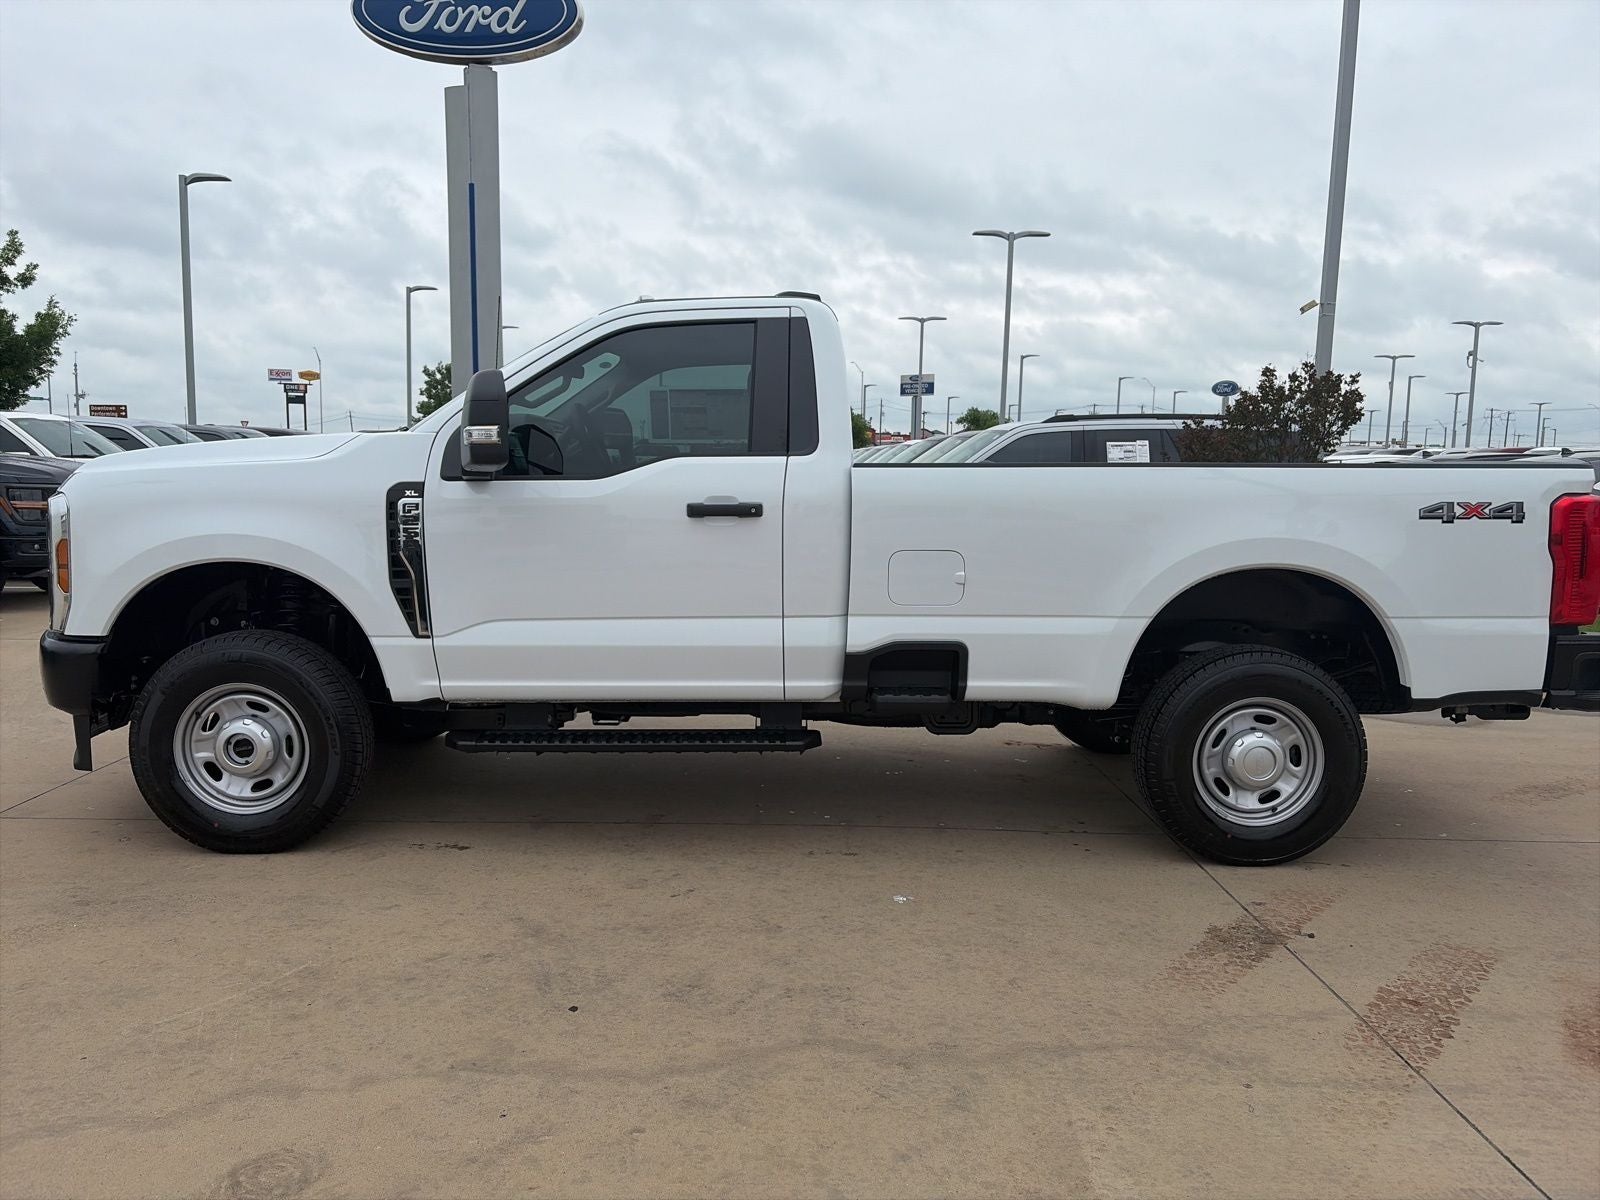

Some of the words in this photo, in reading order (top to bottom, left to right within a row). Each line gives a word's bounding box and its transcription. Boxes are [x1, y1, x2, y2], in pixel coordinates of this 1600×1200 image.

[399, 0, 527, 34] Ford
[270, 370, 291, 378] Exxon
[1215, 384, 1233, 393] Ford
